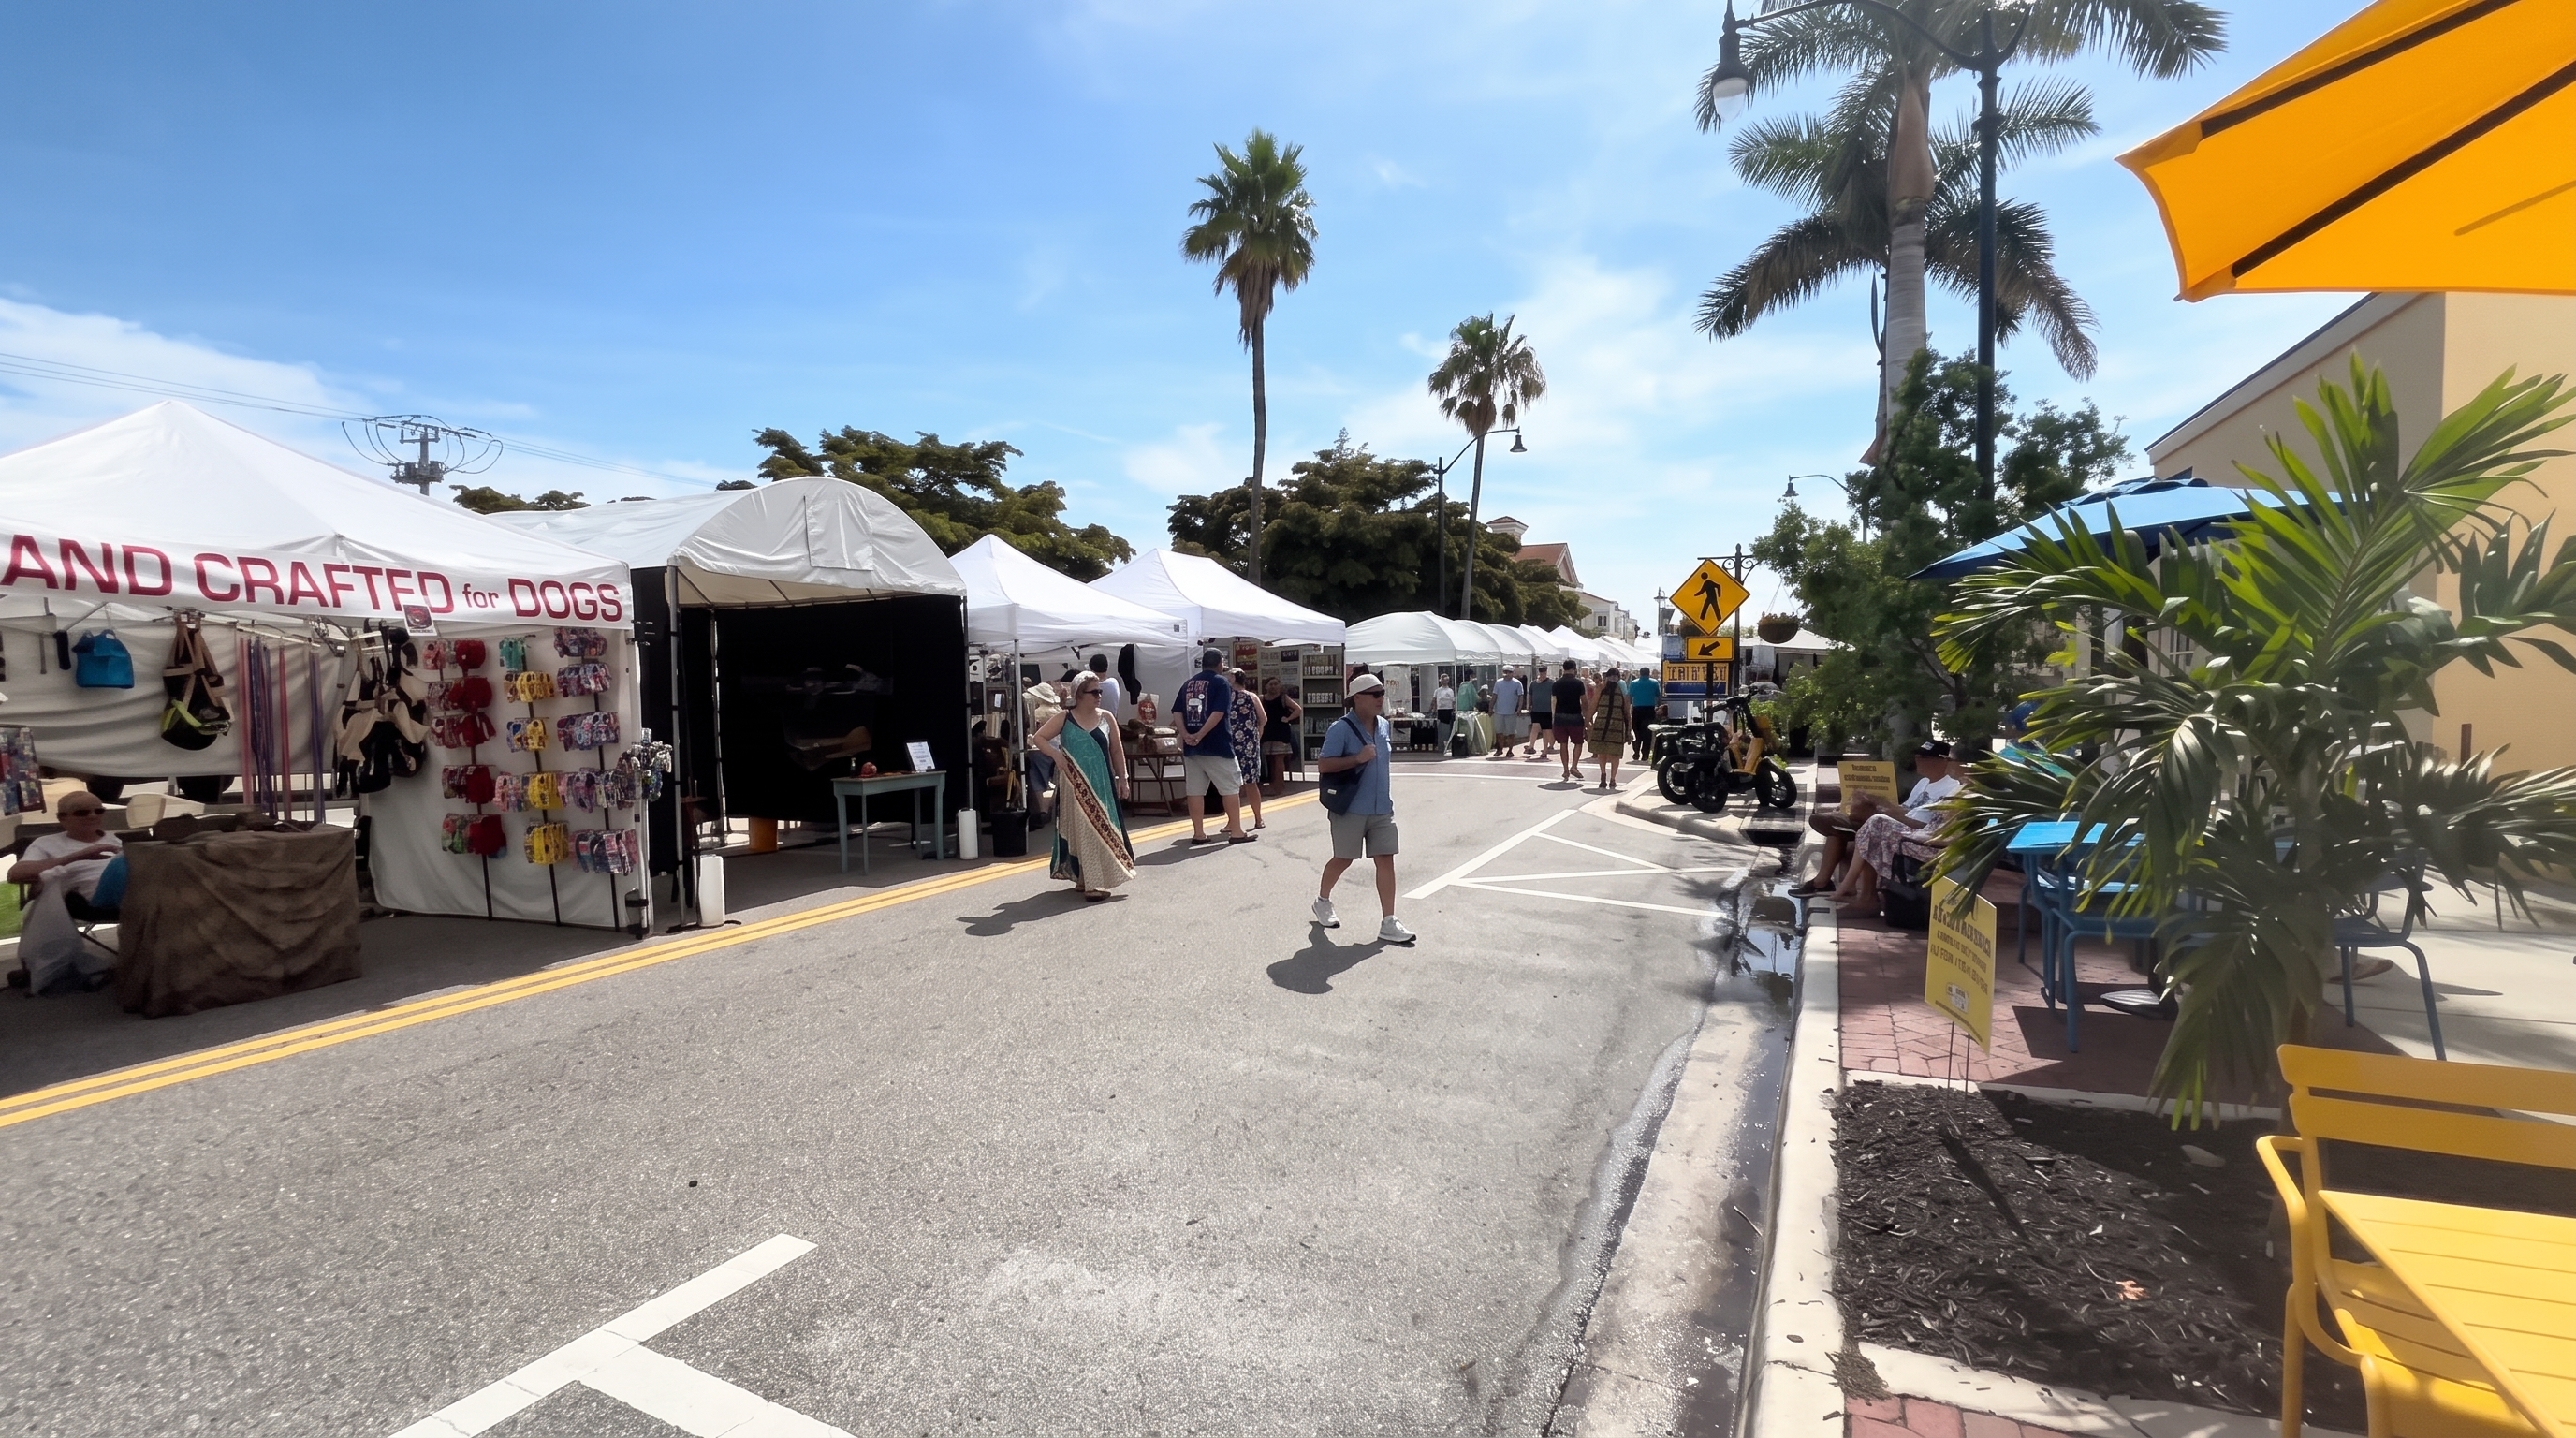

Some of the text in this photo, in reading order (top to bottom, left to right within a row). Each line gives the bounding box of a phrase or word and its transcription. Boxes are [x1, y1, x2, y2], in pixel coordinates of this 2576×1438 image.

[0, 534, 622, 622] AND CRAFTED for DOGS
